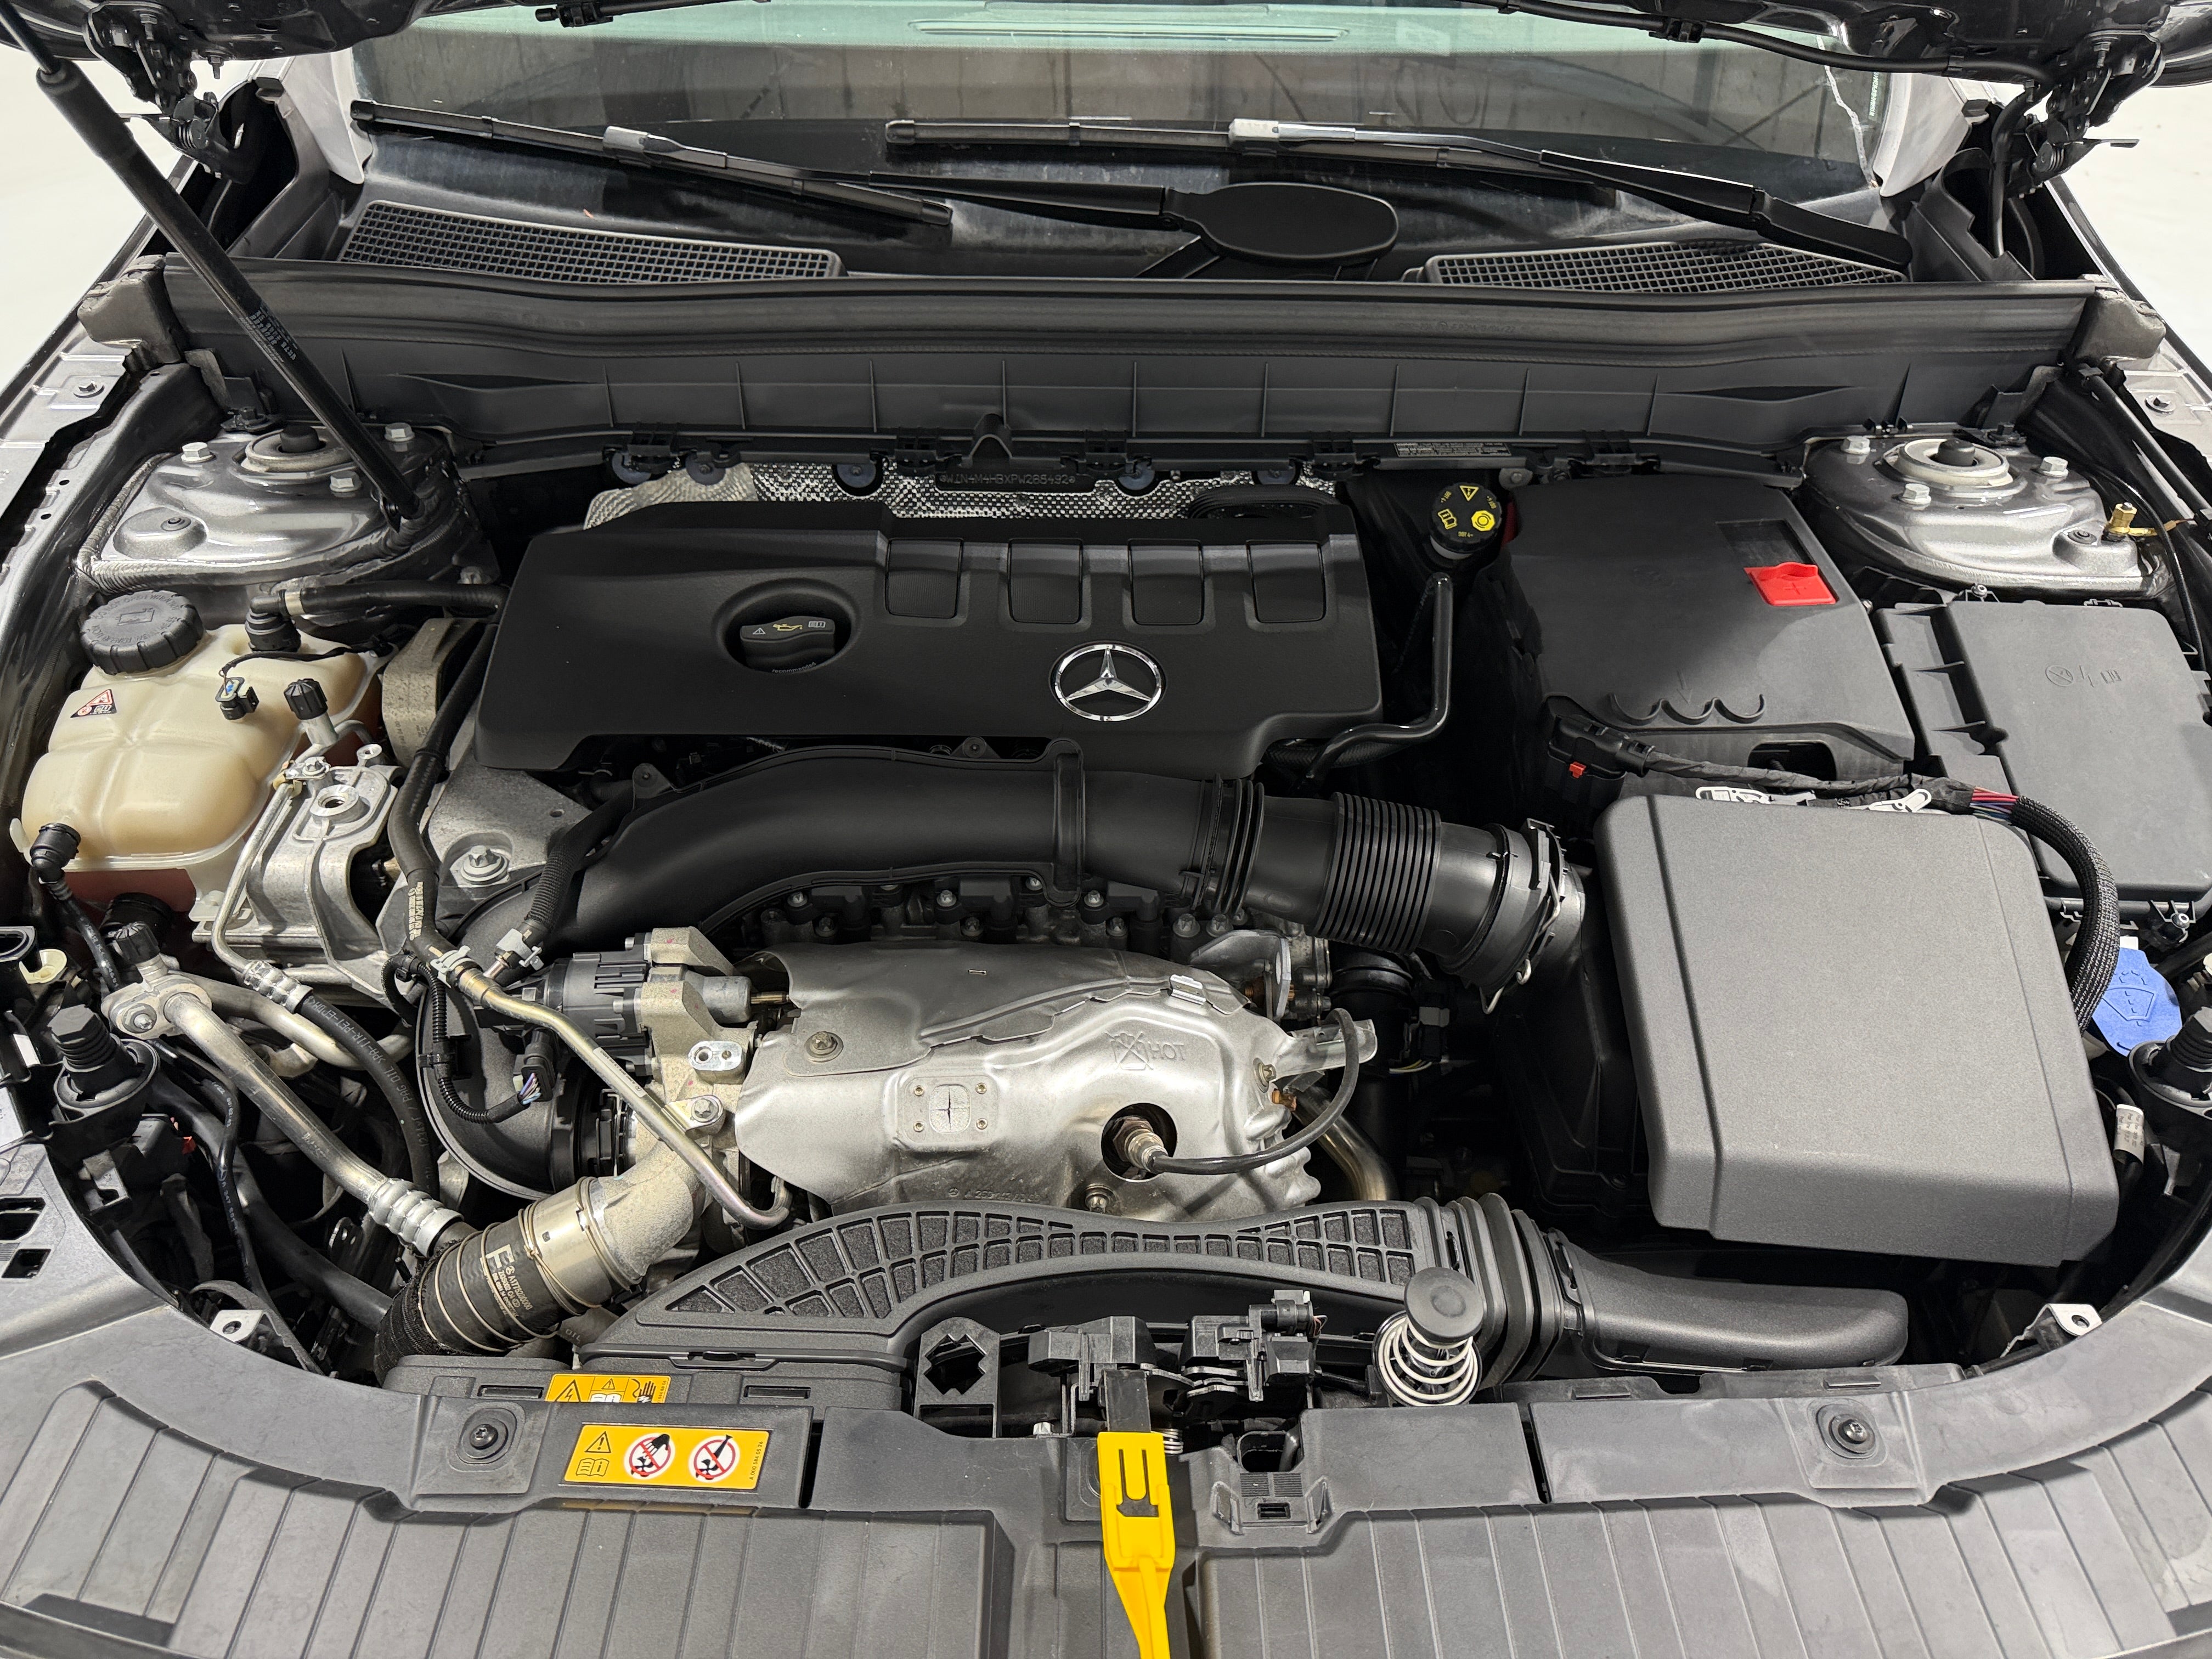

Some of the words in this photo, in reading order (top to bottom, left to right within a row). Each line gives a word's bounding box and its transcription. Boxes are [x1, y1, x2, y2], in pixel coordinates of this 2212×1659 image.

[772, 662, 817, 673] recommended
[1147, 1041, 1186, 1061] HOT
[383, 1065, 401, 1083] OIL
[397, 1085, 413, 1102] PAG
[566, 1329, 581, 1341] OIL
